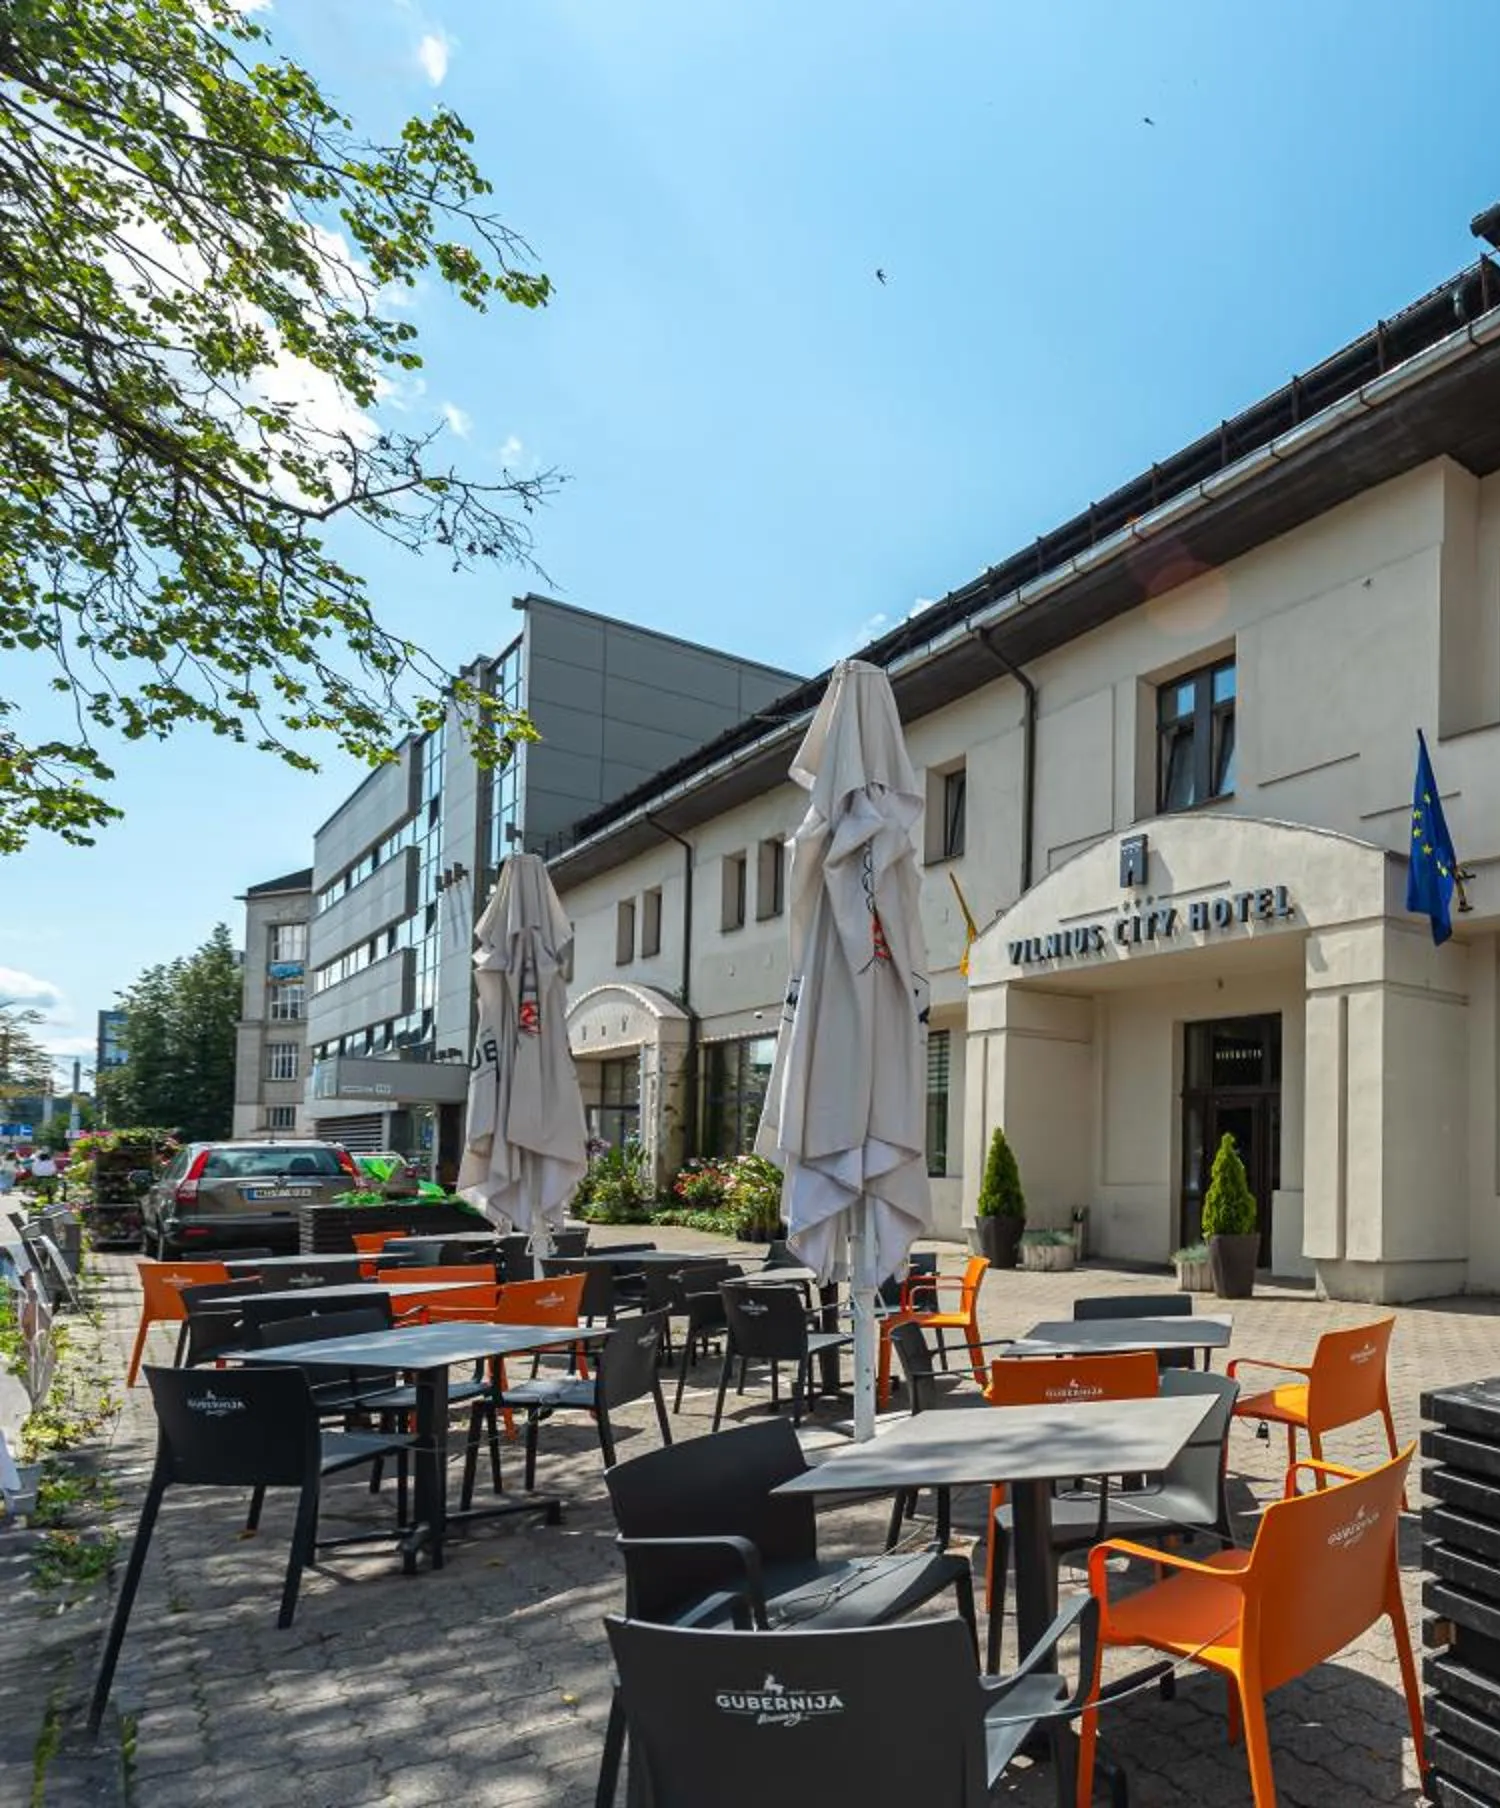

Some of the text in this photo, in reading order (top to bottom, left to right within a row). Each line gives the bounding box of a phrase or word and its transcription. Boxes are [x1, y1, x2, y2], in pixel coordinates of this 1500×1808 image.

[1008, 885, 1295, 966] VILNIUS CITY HOTEL
[716, 1695, 844, 1711] GUBERNIJA
